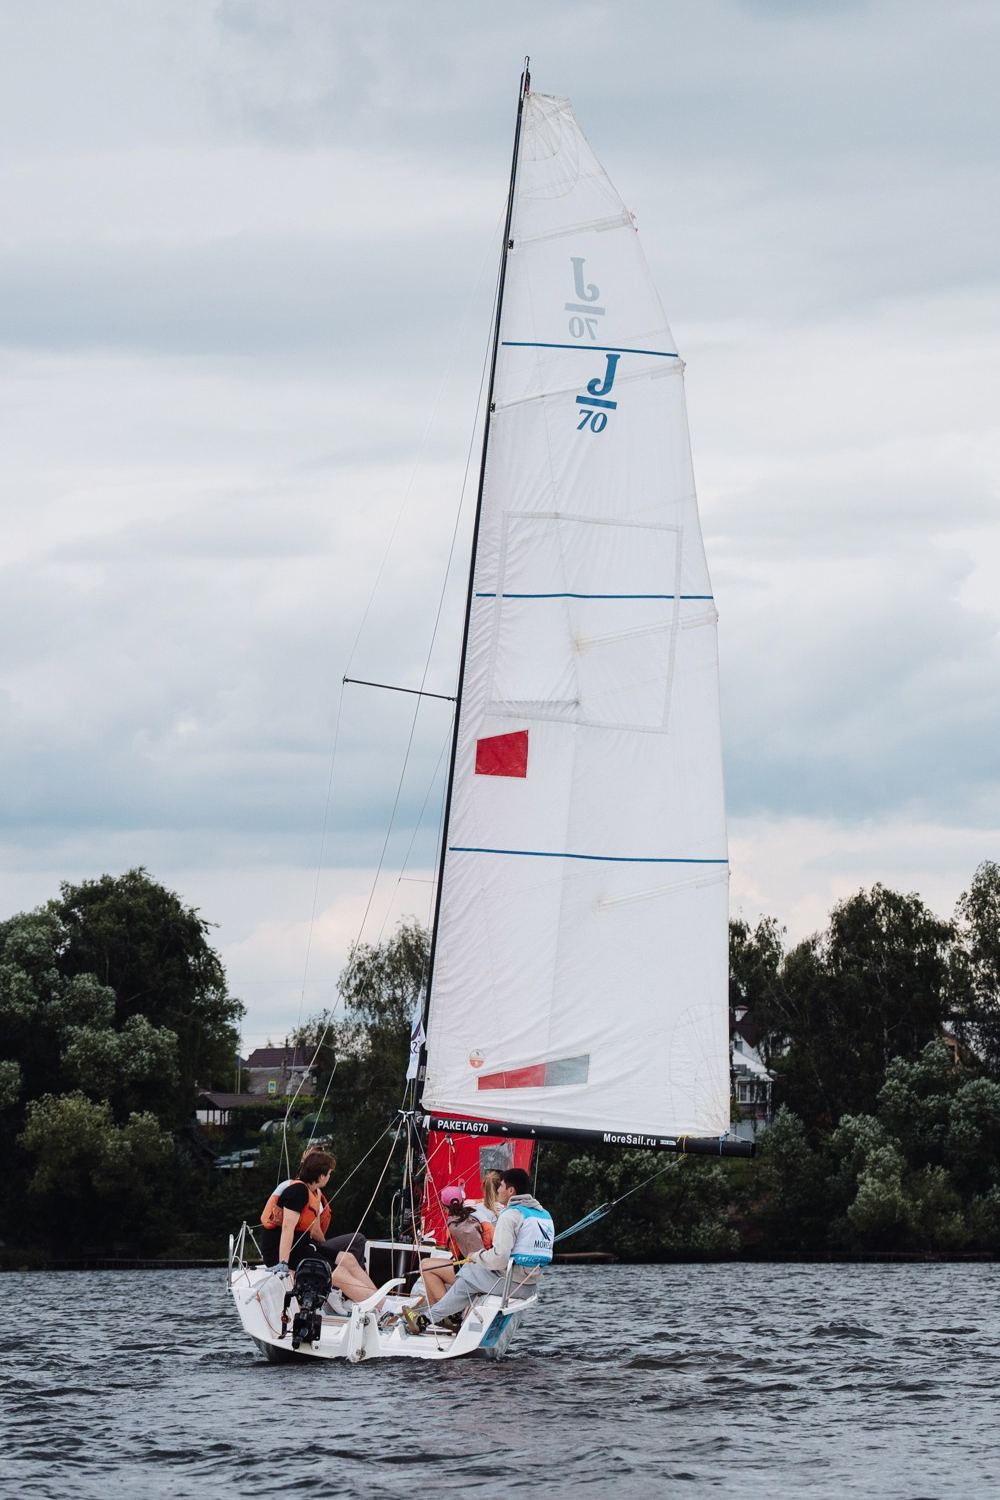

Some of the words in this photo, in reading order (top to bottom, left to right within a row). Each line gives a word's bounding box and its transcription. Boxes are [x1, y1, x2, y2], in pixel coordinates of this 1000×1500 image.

[586, 353, 621, 396] J
[576, 409, 608, 434] 70
[603, 1132, 657, 1146] MoreSail.ru
